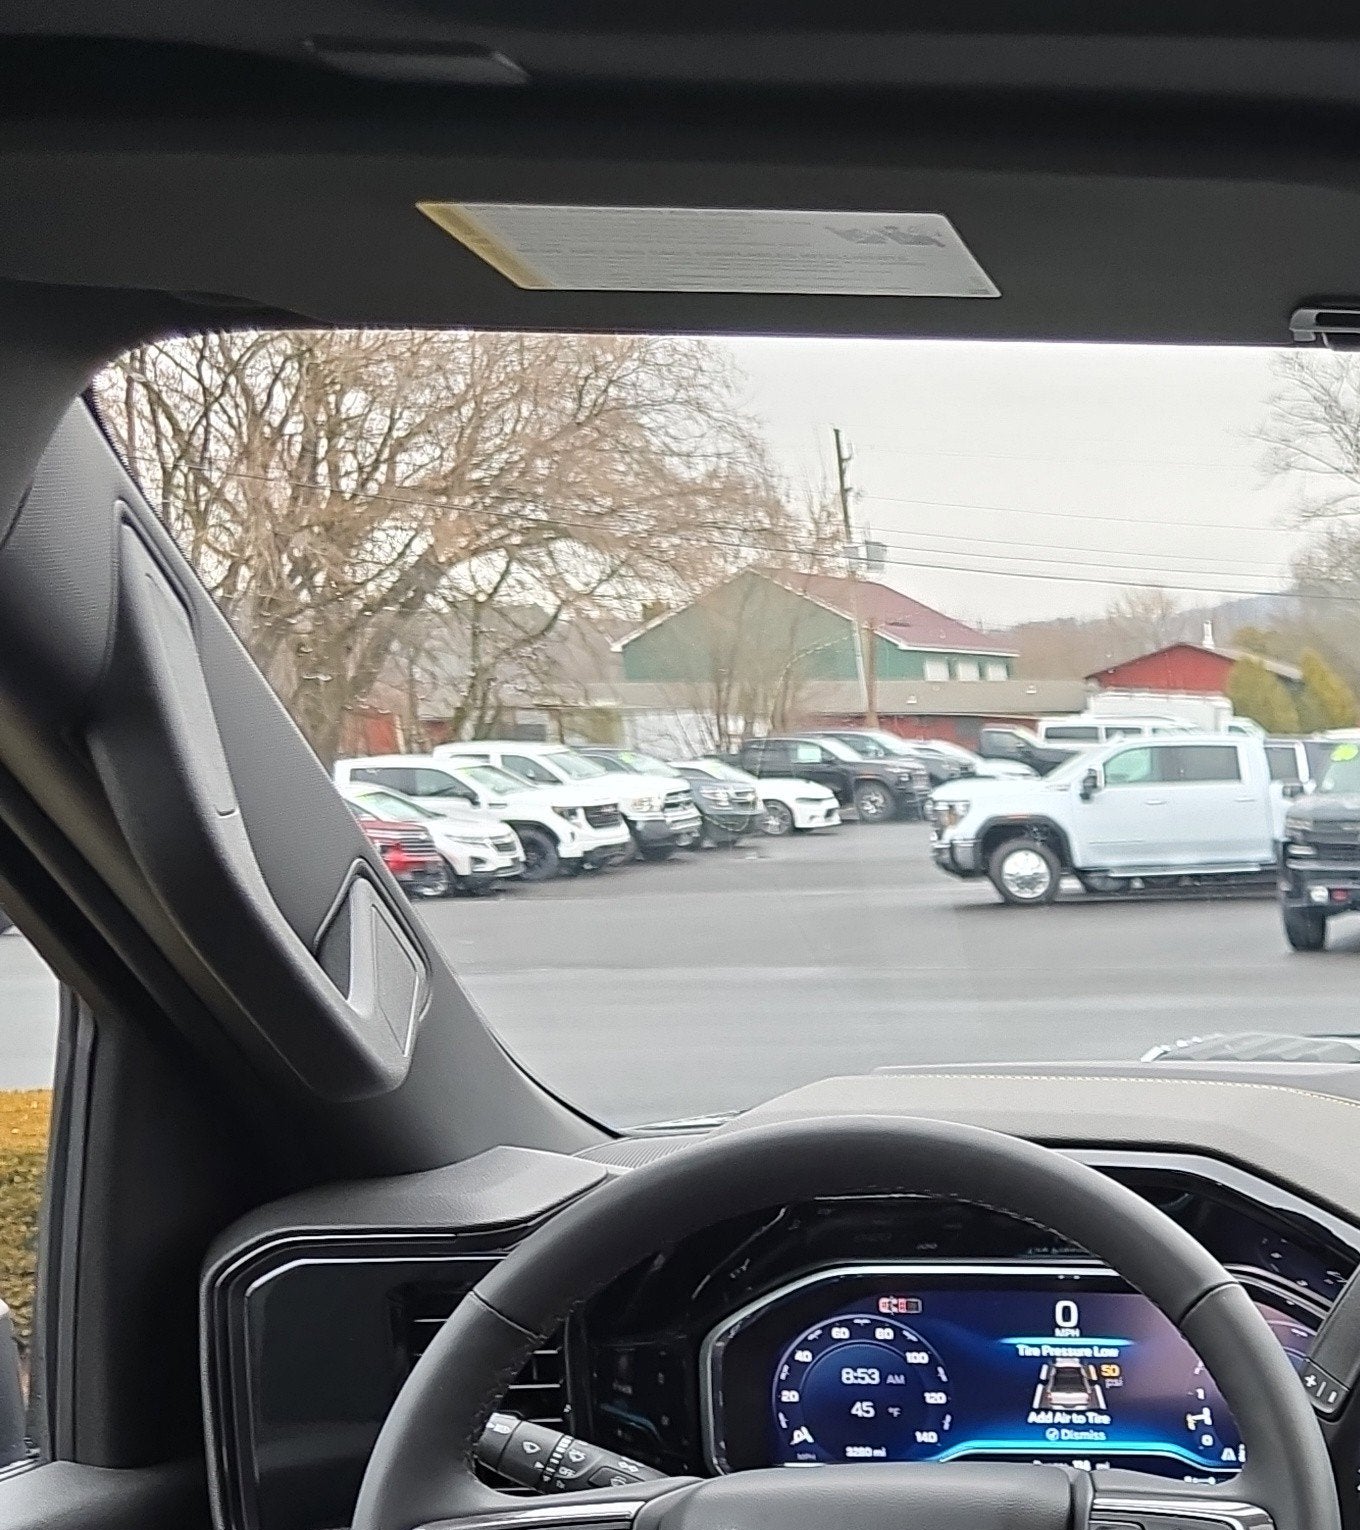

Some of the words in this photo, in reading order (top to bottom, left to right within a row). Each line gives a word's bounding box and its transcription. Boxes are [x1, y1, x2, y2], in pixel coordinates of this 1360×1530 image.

[1055, 1300, 1078, 1328] 0
[1055, 1328, 1080, 1337] MPH
[1016, 1344, 1040, 1357] Tire
[1042, 1345, 1092, 1358] Pressure
[1093, 1346, 1119, 1358] Low
[841, 1368, 880, 1384] 8:53
[886, 1375, 905, 1385] AM
[851, 1401, 875, 1418] 45
[1027, 1411, 1053, 1424] Add
[1054, 1411, 1072, 1424] Air
[1072, 1413, 1086, 1424] to
[1087, 1412, 1111, 1424] Tire
[1061, 1428, 1107, 1440] Dismiss
